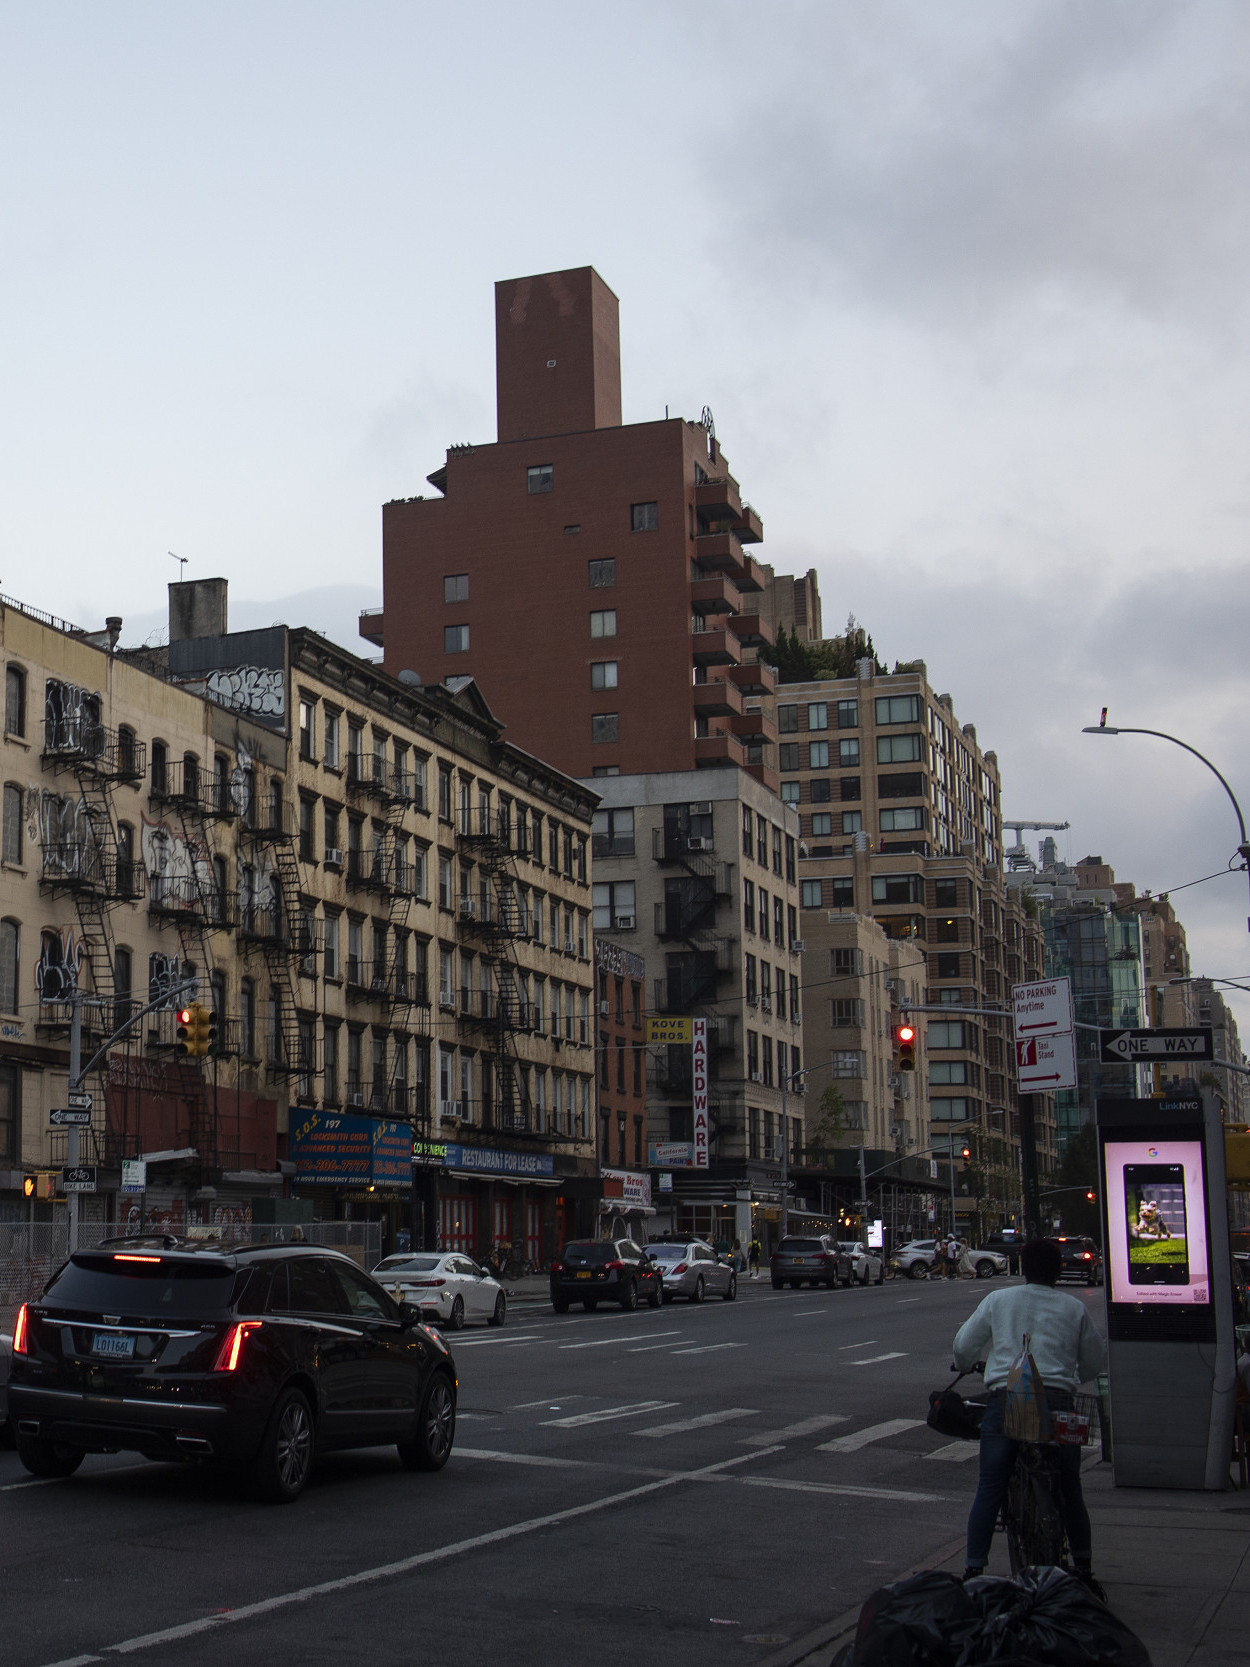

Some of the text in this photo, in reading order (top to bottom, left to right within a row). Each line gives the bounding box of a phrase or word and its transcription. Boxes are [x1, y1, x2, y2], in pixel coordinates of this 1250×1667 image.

[1015, 985, 1057, 1001] NO PARKING
[1016, 1001, 1044, 1016] Anytime
[652, 1020, 685, 1029] KOVE
[651, 1031, 688, 1041] BROS.
[1038, 1041, 1049, 1050] Taxi
[1117, 1038, 1198, 1053] ONE WAY
[1038, 1050, 1055, 1060] Stand
[693, 1021, 707, 1167] HARDWARE
[1159, 1101, 1199, 1111] LinkNYC
[54, 1113, 88, 1121] ONE WAY
[295, 1113, 321, 1142] S.O.S.
[325, 1119, 341, 1129] 197
[310, 1132, 348, 1141] LOCKSMITH
[299, 1145, 336, 1153] ADVANCED
[337, 1145, 372, 1153] SECURITY
[658, 1147, 688, 1156] California
[461, 1149, 503, 1169] RESTAURANT
[504, 1153, 516, 1170] FOR
[517, 1155, 536, 1172] LEASE
[295, 1160, 370, 1173] 212-206-7777
[64, 1182, 94, 1190] BIKE LANE
[626, 1175, 644, 1187] Bros
